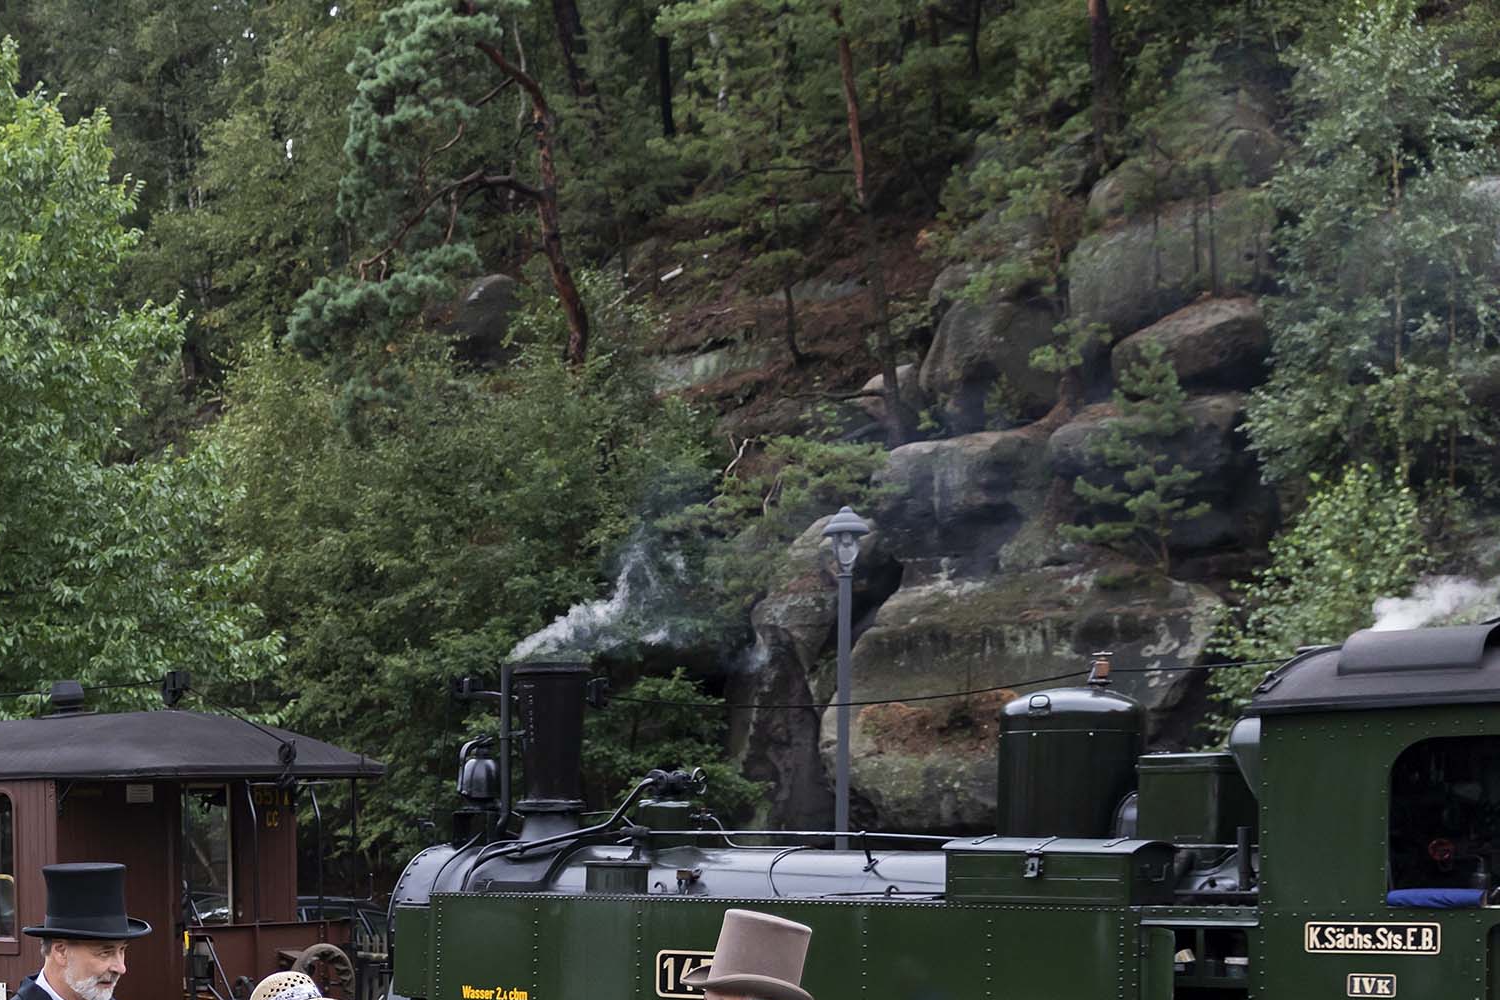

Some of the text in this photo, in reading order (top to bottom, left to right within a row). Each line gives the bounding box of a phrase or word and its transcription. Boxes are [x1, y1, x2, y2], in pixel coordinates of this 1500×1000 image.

[1308, 926, 1437, 951] K.Sächs.Sts.E.B.
[662, 957, 714, 992] 14
[462, 985, 495, 1000] Wasser
